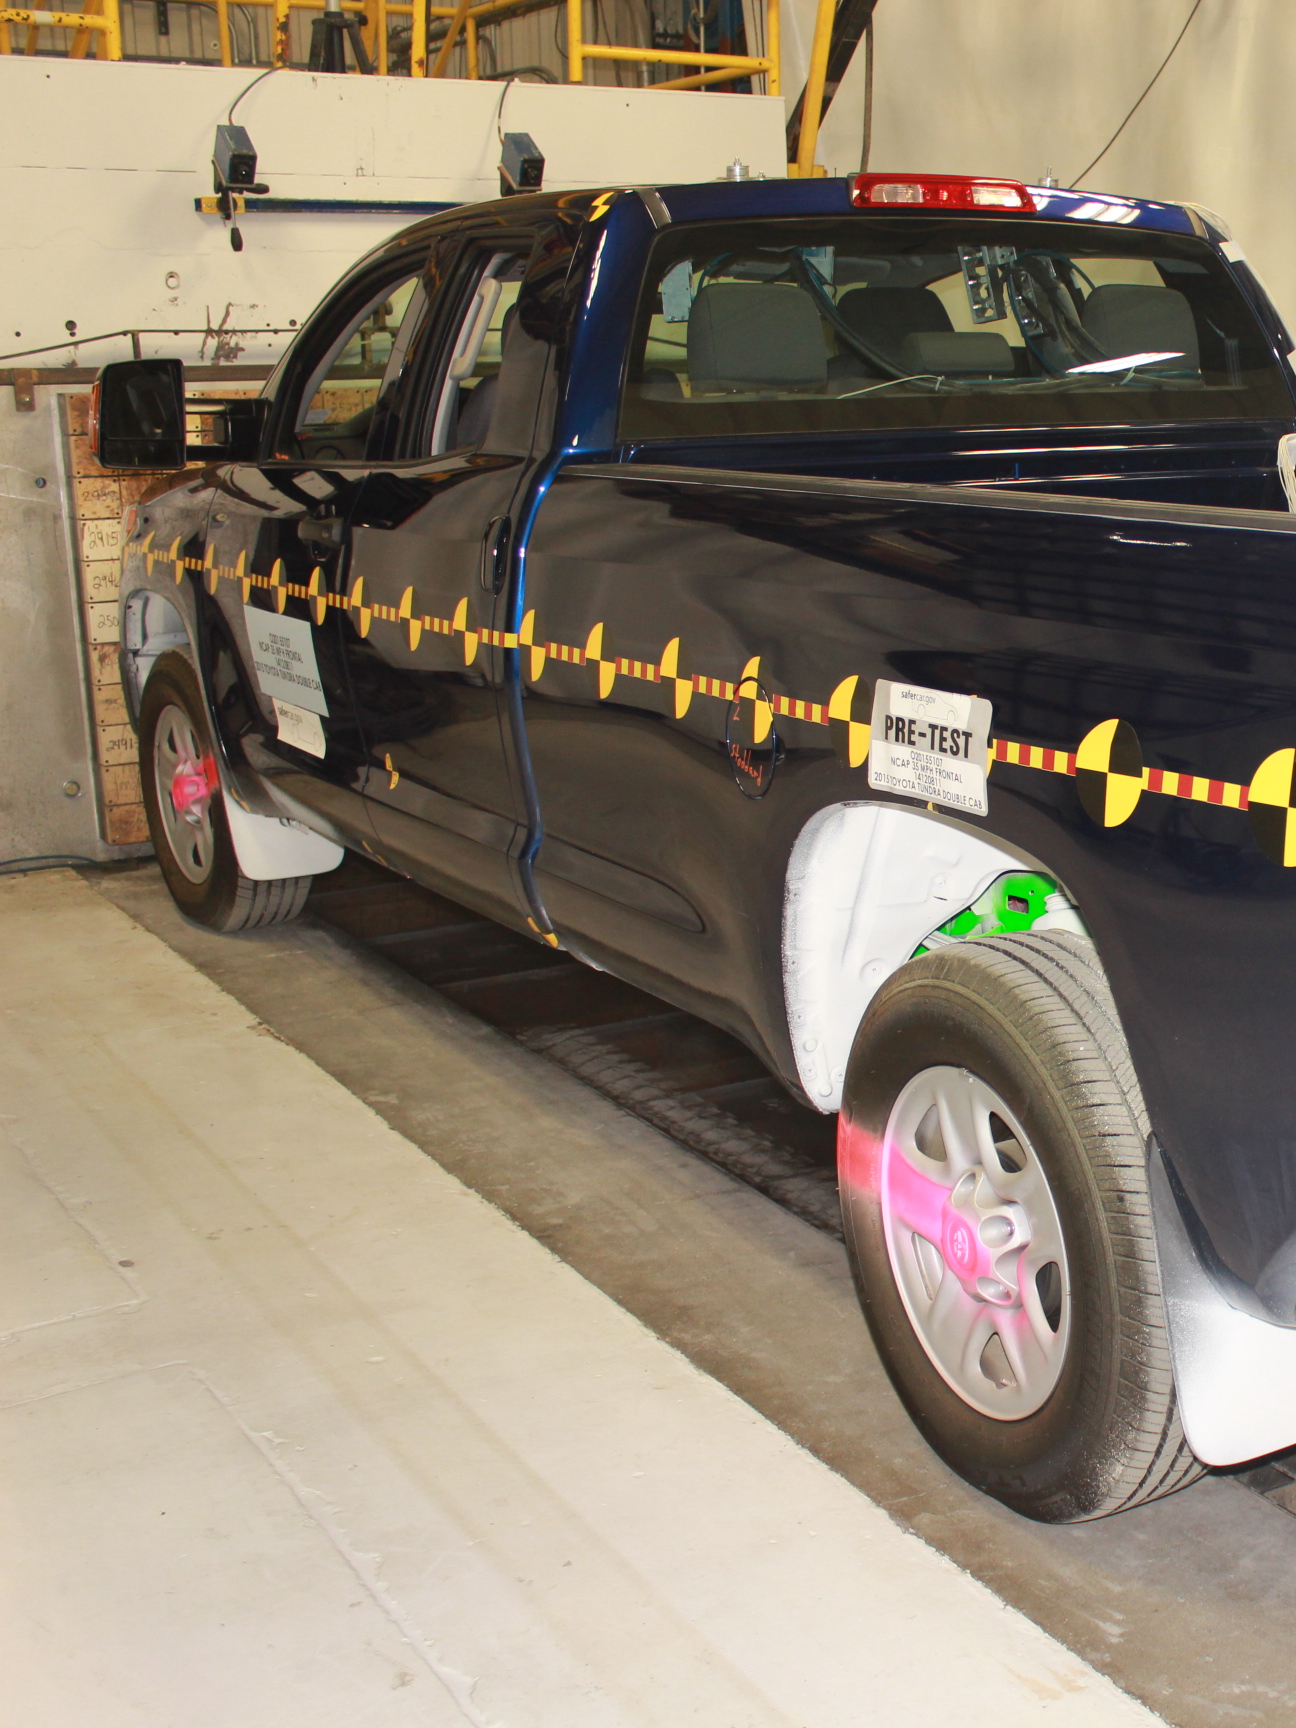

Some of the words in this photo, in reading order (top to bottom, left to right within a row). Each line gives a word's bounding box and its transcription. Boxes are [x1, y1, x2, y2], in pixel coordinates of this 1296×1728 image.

[89, 530, 118, 549] 2915
[901, 690, 936, 705] safercar.gov
[106, 738, 133, 752] 2491
[884, 714, 973, 759] PRE-TEST
[891, 756, 910, 769] NCAP
[912, 761, 919, 771] 35
[920, 763, 933, 775] MPH
[935, 767, 963, 784] FRONTAL
[917, 782, 941, 798] TUNDRA
[942, 789, 967, 806] DOUBLE
[968, 796, 983, 810] CAB
